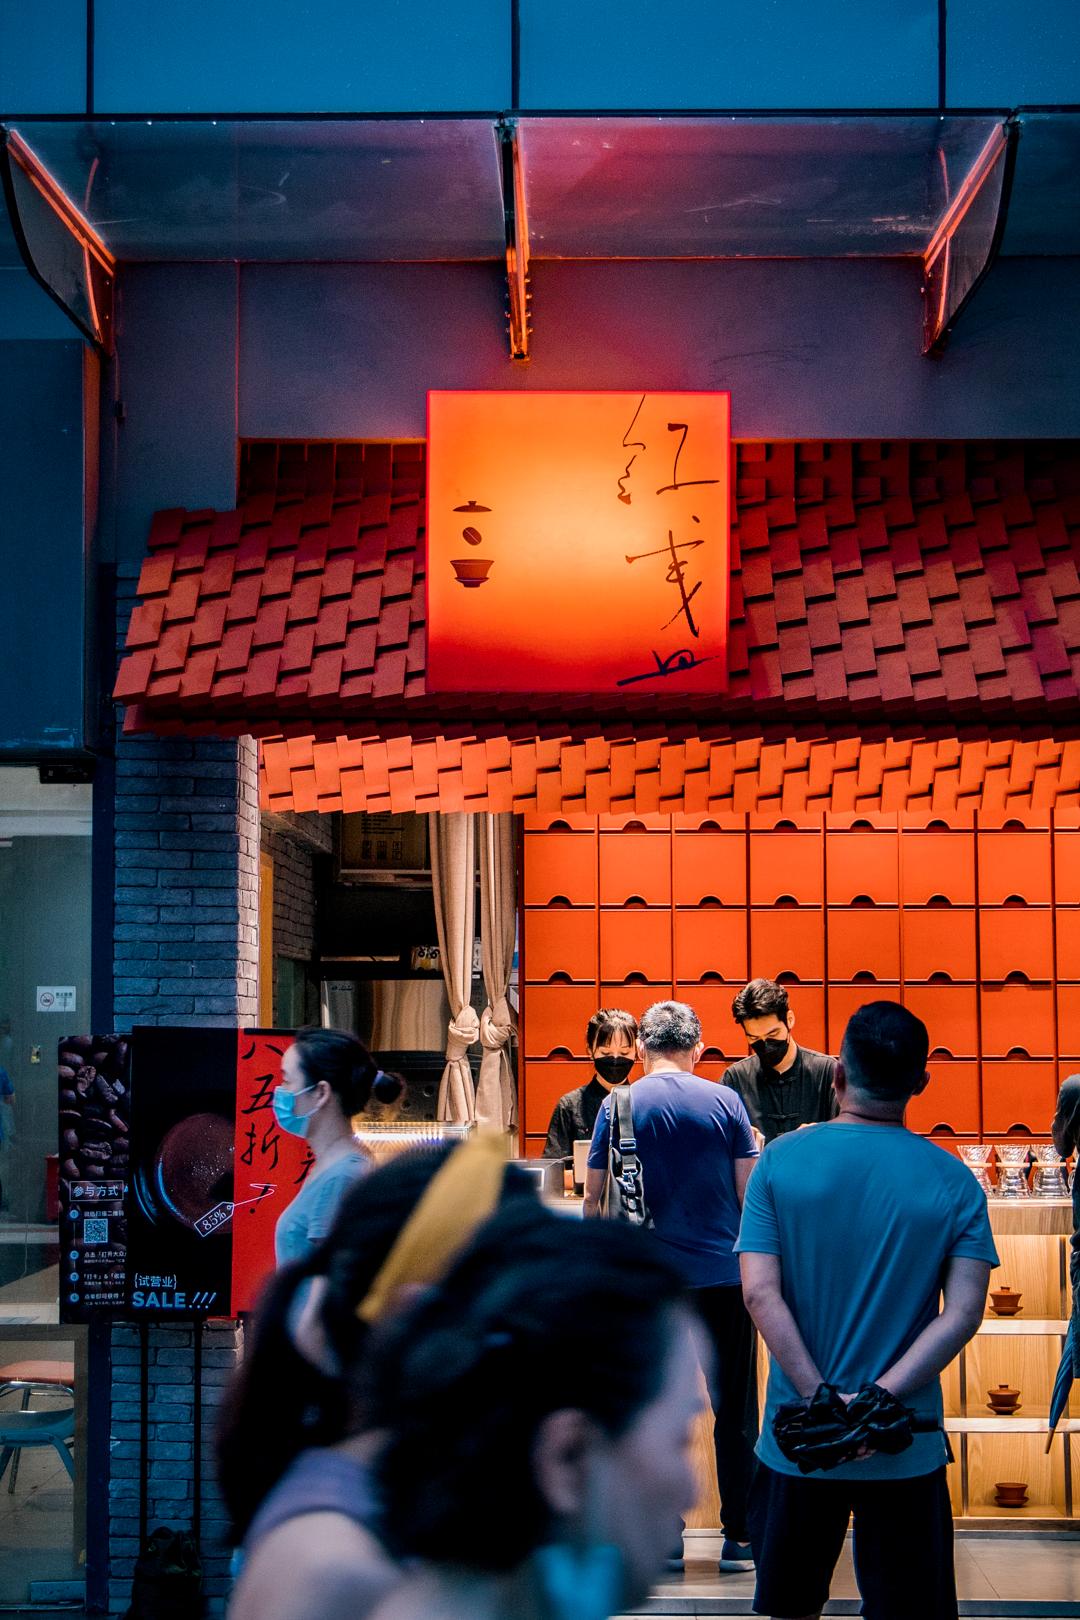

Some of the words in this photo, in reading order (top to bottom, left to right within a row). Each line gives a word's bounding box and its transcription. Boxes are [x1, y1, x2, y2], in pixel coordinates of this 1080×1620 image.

[73, 1185, 119, 1197] 参与方式
[202, 1209, 227, 1231] 85%
